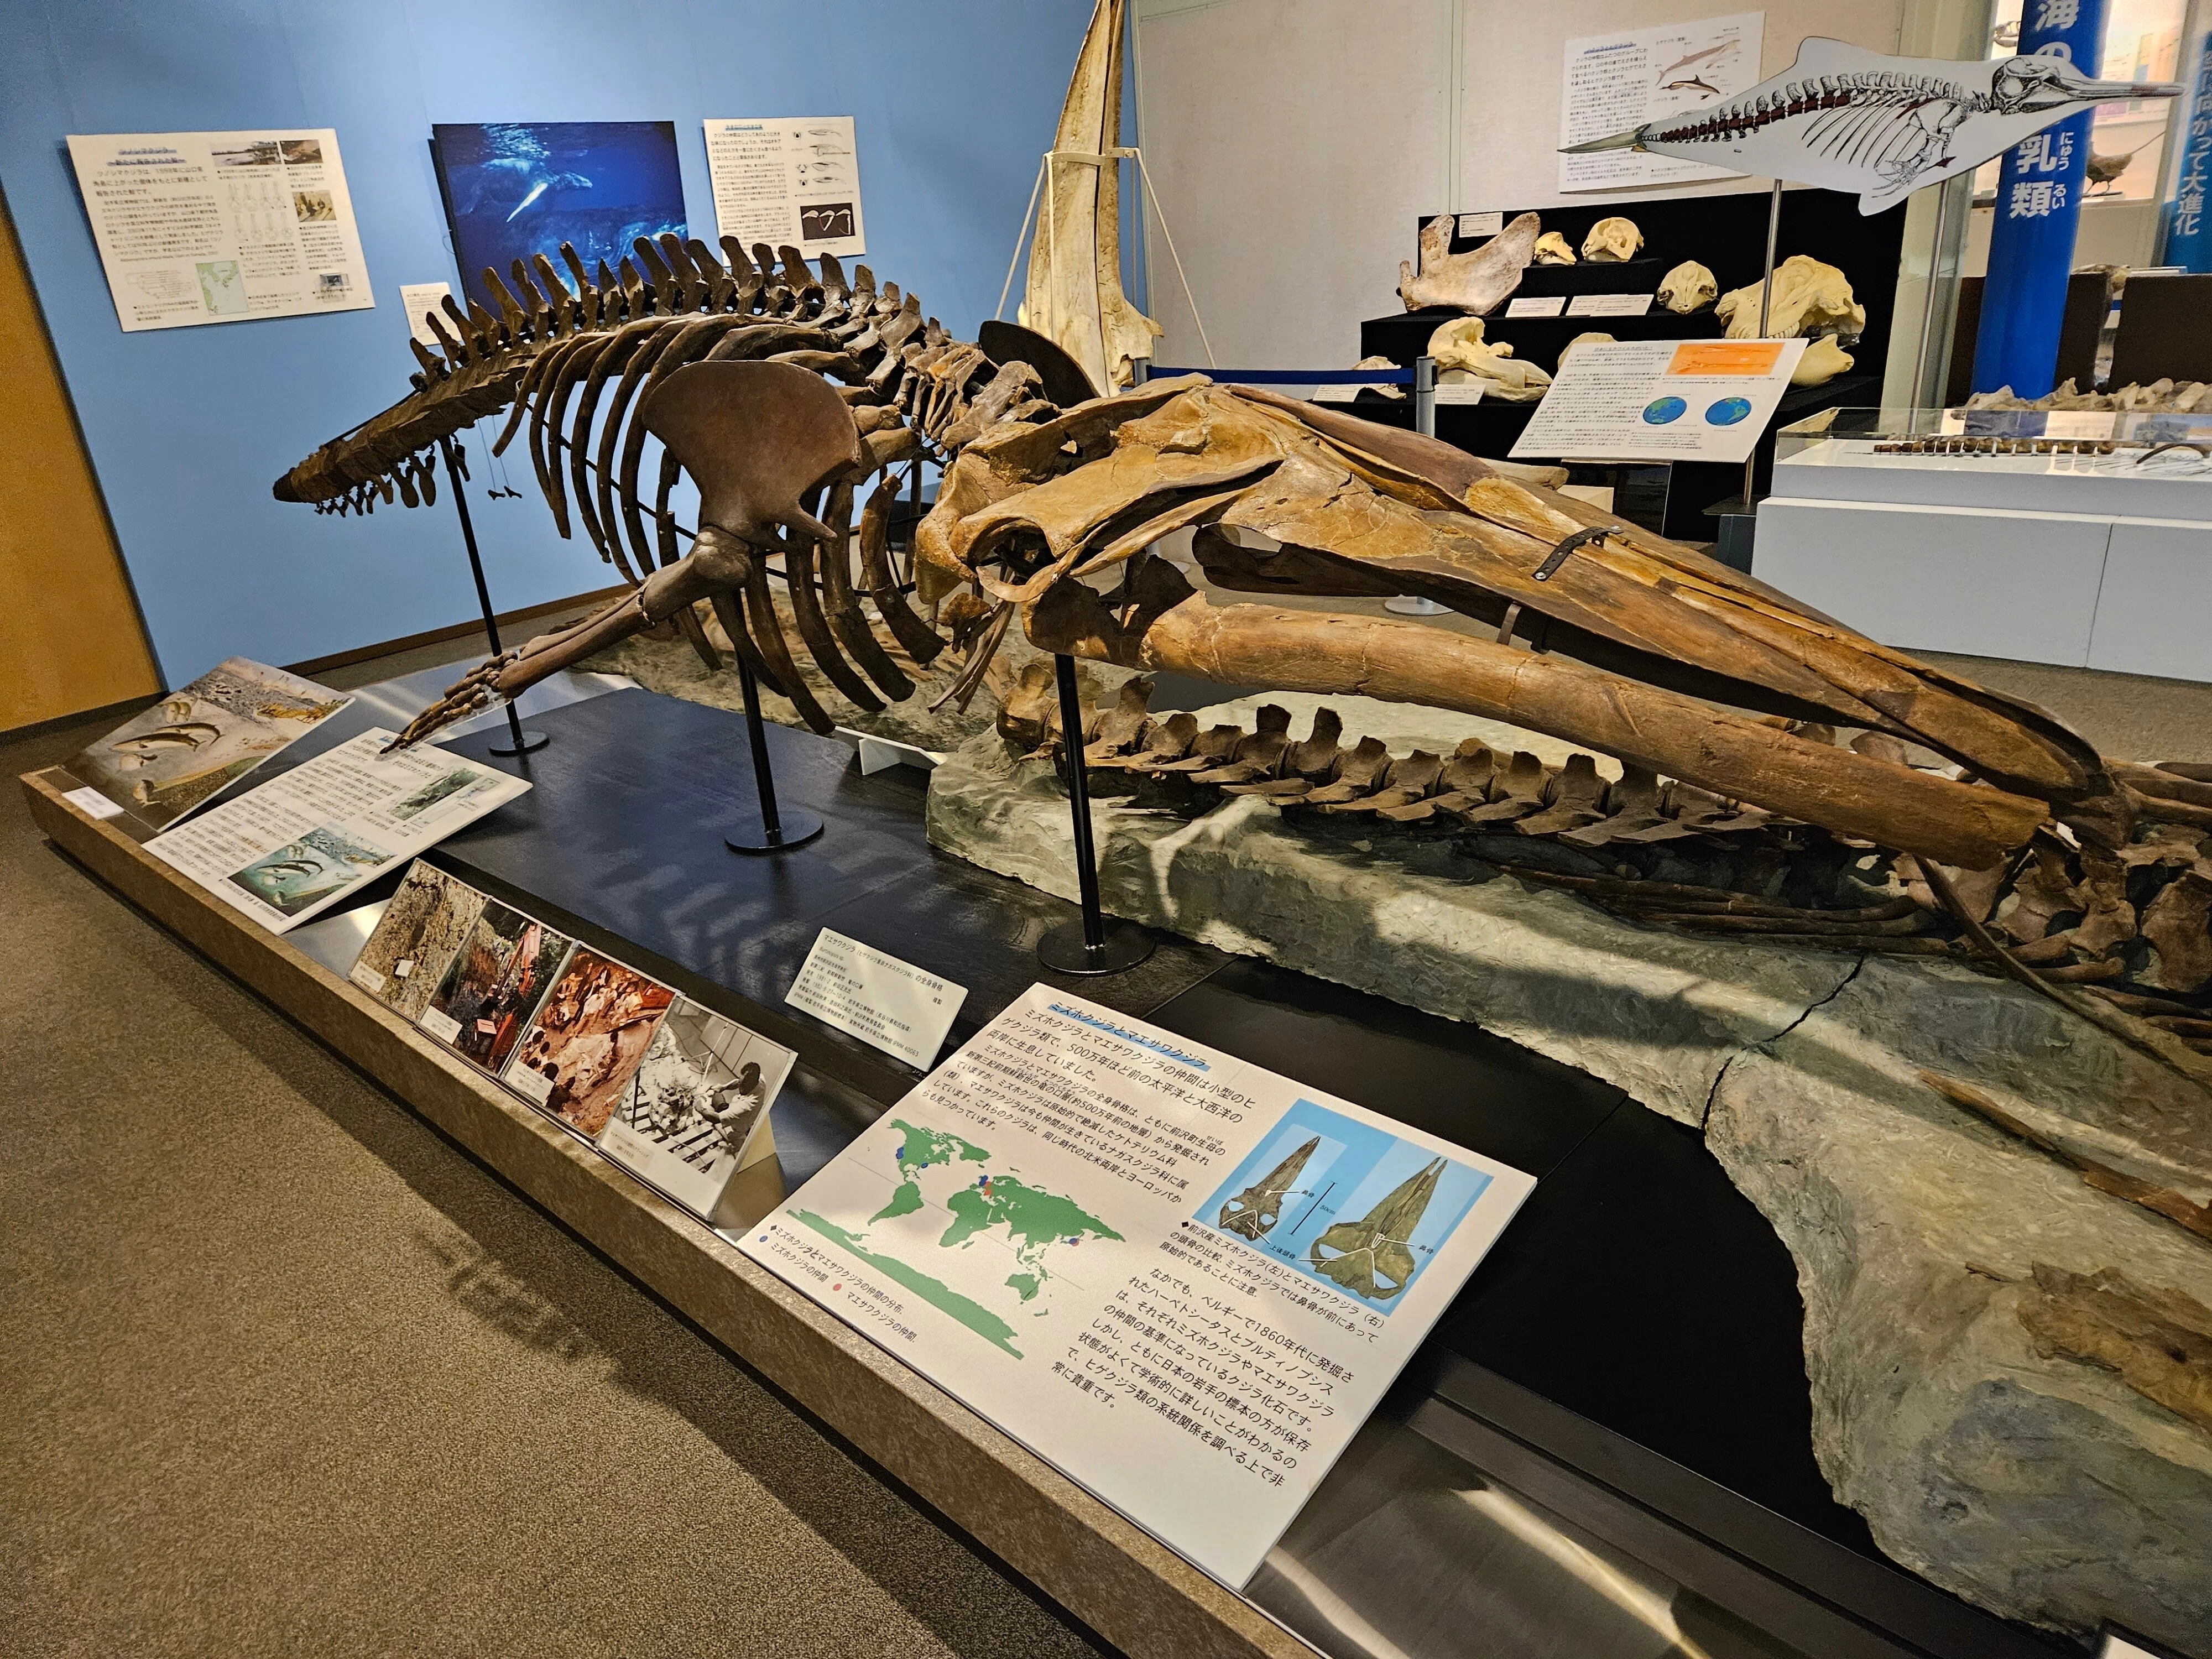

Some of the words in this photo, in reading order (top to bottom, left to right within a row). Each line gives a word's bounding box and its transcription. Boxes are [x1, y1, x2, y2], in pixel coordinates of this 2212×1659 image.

[2052, 183, 2067, 210] るい
[2058, 132, 2074, 170] にゅう
[985, 1028, 1103, 1083] 両岸に生息していました。
[999, 1016, 1246, 1124] ゲクジラ類で、500万年ほど前の太平洋と大西洋の
[1023, 1008, 1259, 1109] ミズホクジラとマエサワクジラの仲間は小型のヒ
[1050, 1000, 1209, 1068] ミズホクジラとマエサワクジラ
[920, 1088, 1000, 1131] らも見つかっています。
[931, 1079, 1185, 1205] しています。これらのクジラは、同じ時代の北米両岸とヨーロッパか
[954, 1060, 1179, 1167] ていますが、ミズホクジラは原始的で絶滅したケトテリウム科
[982, 1044, 1229, 1156] ミズホクジラとマエサワクジラの全身骨格は、ともに前沢町生母の
[769, 1241, 830, 1284] ミズホクジラの仲間
[1319, 1204, 1336, 1215] 50cm
[1102, 1302, 1318, 1433] の仲間の基準になっているクジラ化石です。
[1114, 1289, 1336, 1420] は、それぞれミズホクジラやマエサワクジラ
[1126, 1275, 1337, 1396] れたハーペトシータスとブルティノプシス
[1147, 1267, 1356, 1384] なかでも、ベルギーで1860年代に発掘さ
[1048, 1360, 1121, 1410] 常に貴重です。
[1063, 1345, 1287, 1489] で、ヒゲクジラ類の系統関係を調べる上で非
[1076, 1331, 1300, 1472] 状態がよくて学術的に詳しいことがわかるの
[1089, 1317, 1313, 1454] しかし、ともに日本の岩手の標本の方が保存
